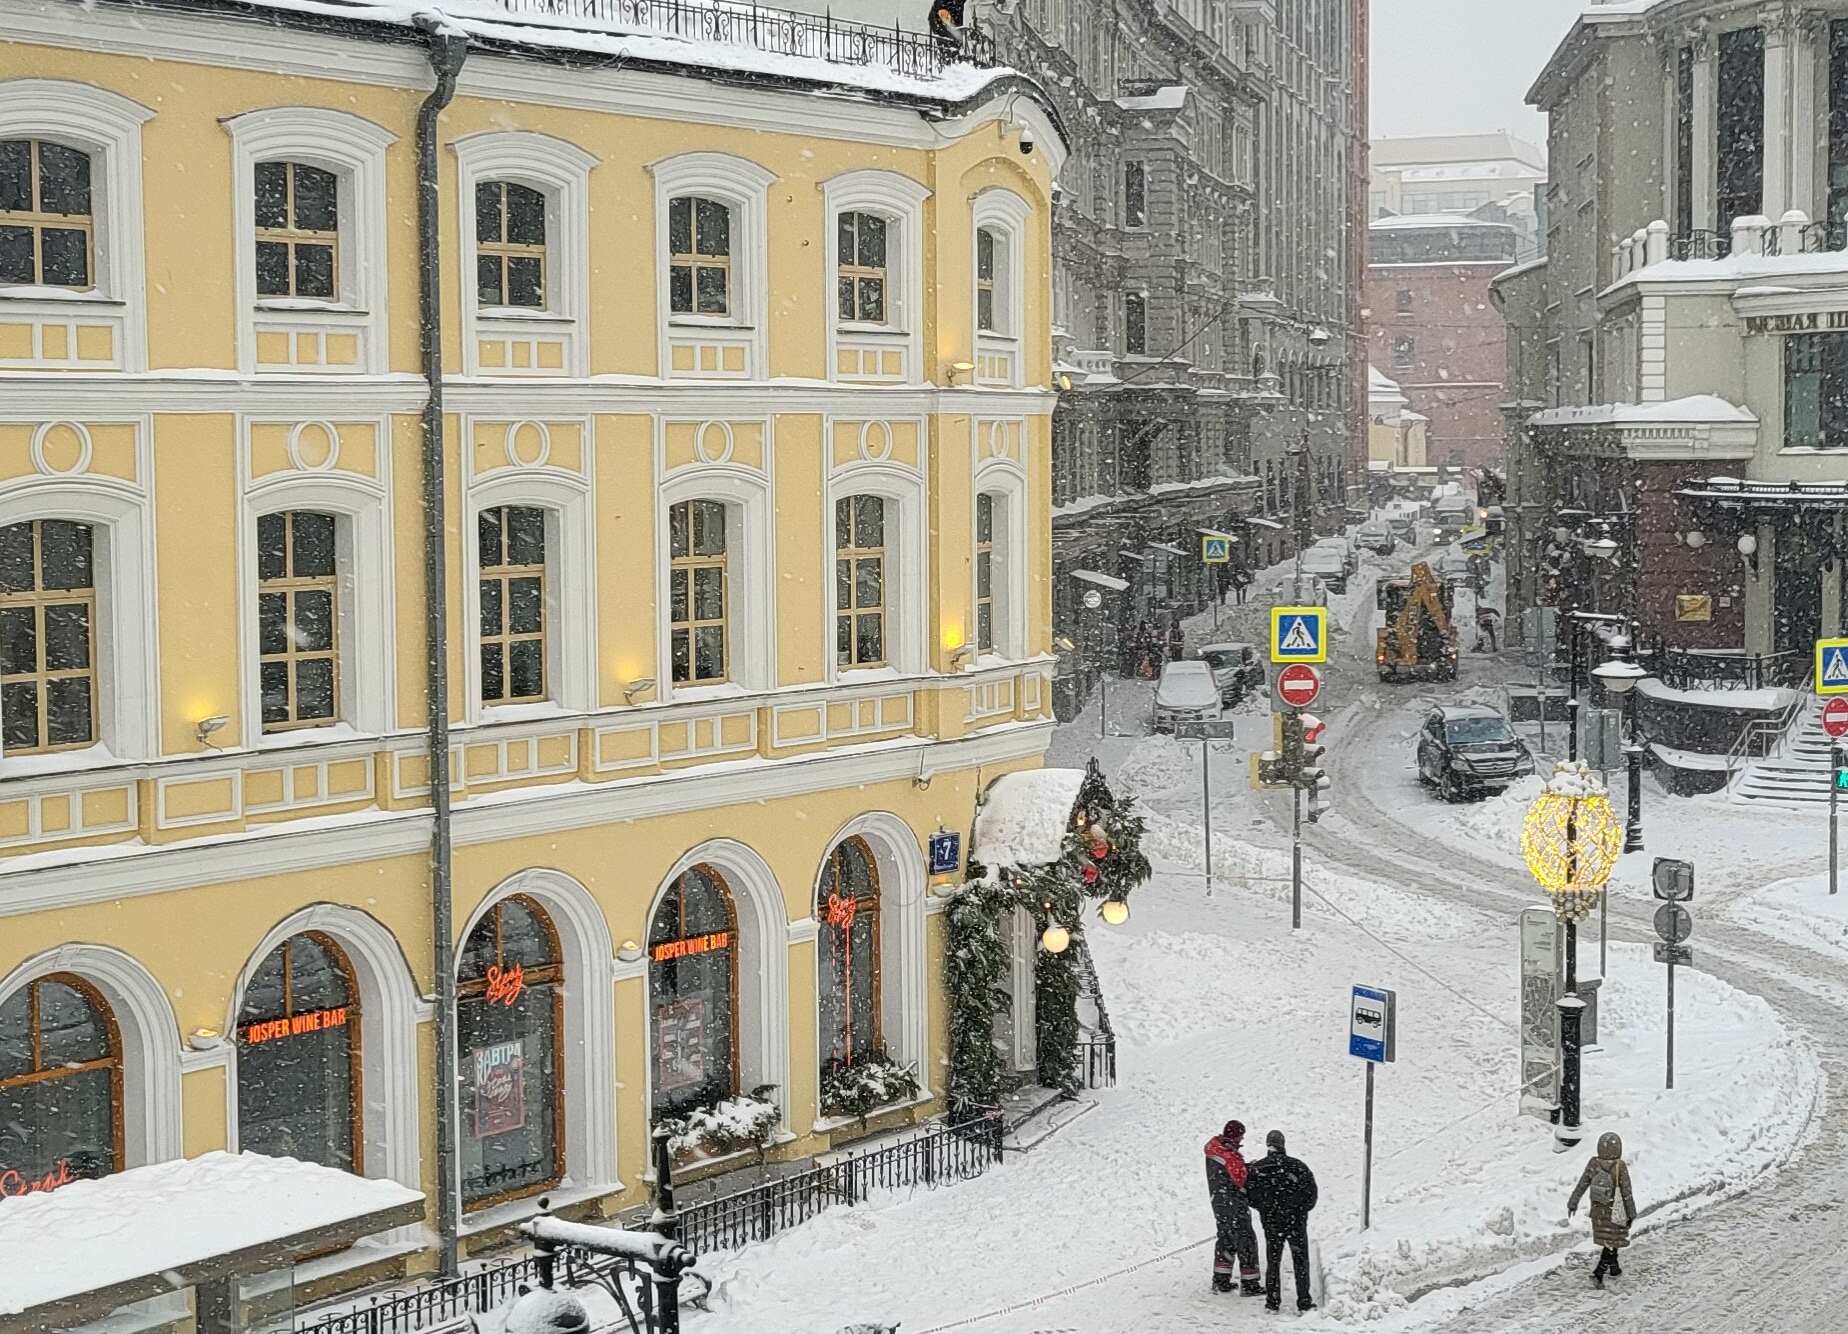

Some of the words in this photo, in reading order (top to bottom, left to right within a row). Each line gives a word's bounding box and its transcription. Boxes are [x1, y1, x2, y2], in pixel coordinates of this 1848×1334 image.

[943, 840, 952, 860] 7
[655, 941, 687, 962] JOSPER
[687, 935, 710, 955] WINE
[709, 932, 728, 950] BAR
[248, 1019, 290, 1045] JOSPER
[291, 1013, 321, 1035] WINE
[323, 1008, 347, 1029] BAR
